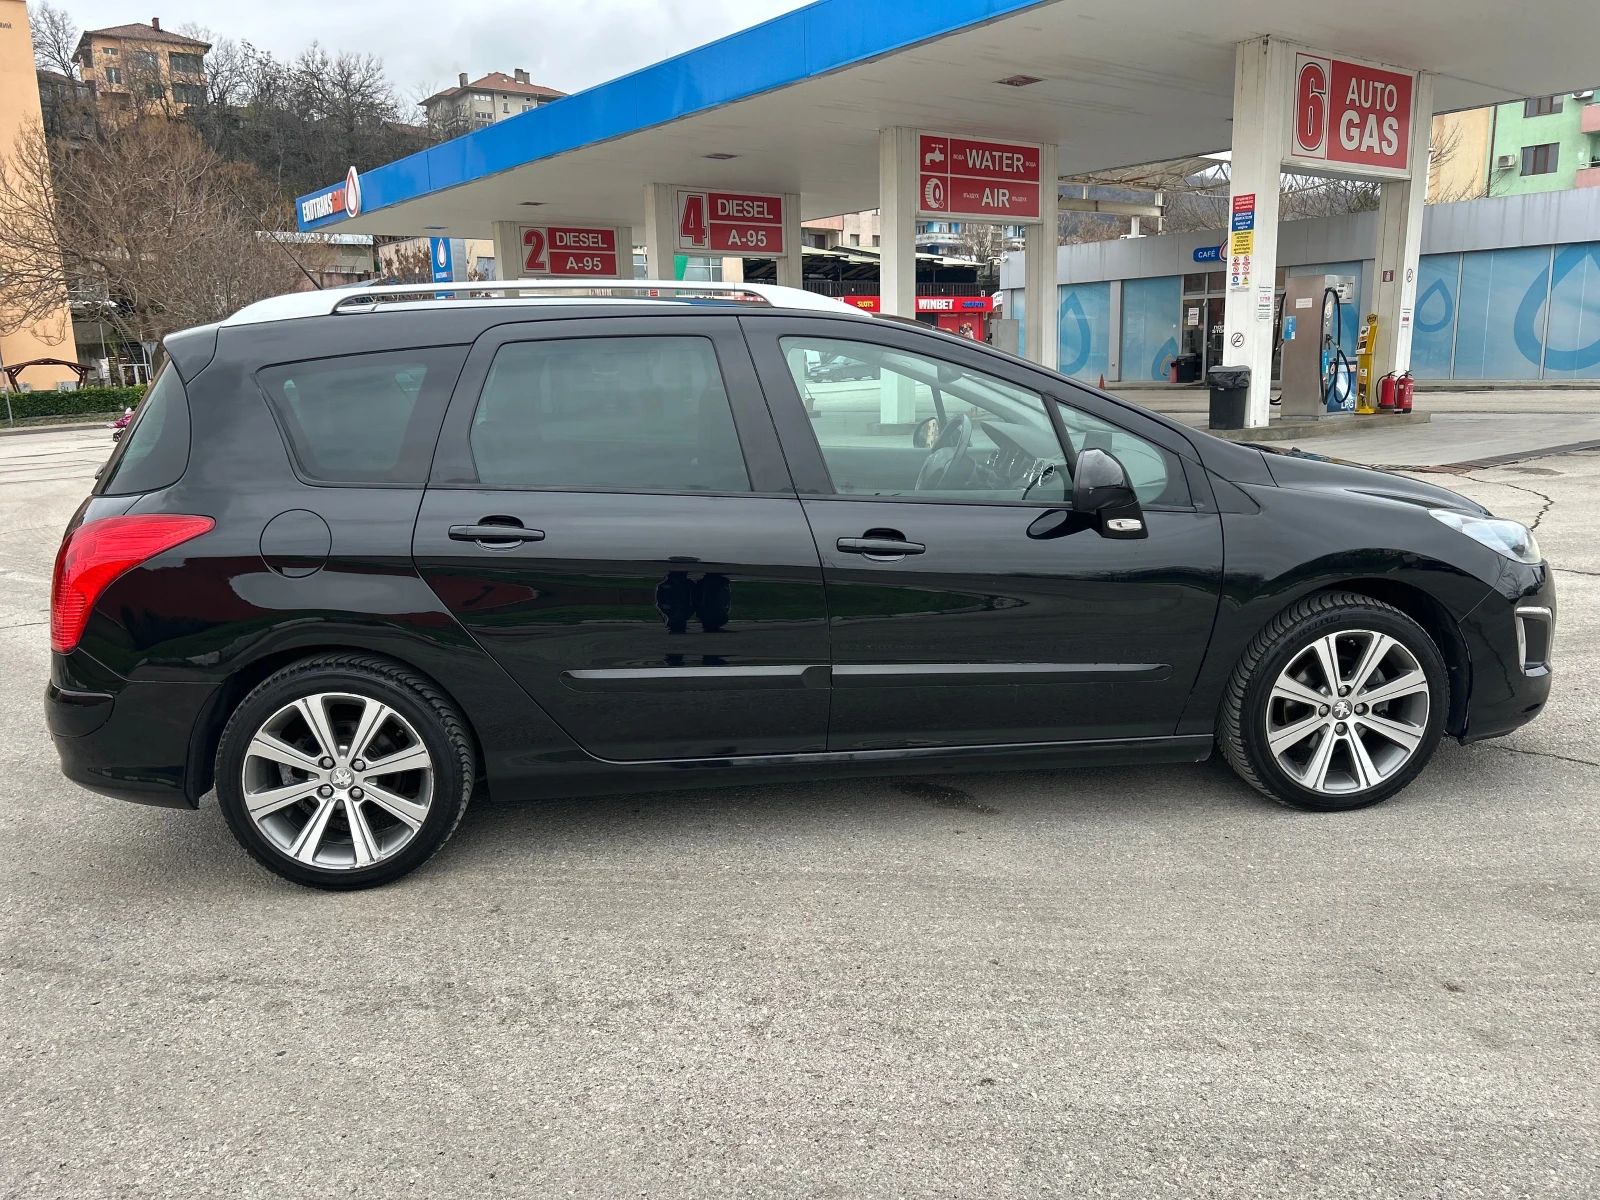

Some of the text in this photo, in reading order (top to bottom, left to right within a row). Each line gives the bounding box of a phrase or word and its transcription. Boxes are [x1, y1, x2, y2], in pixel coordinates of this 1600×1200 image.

[1346, 77, 1398, 112] AUTO
[1296, 62, 1326, 151] 6
[1340, 109, 1399, 156] GAS
[966, 148, 1024, 173] WATER
[981, 187, 1010, 208] AIR
[717, 198, 773, 219] DIESEL
[681, 195, 707, 246] 4
[555, 232, 608, 248] DIESEL
[727, 229, 767, 247] A-95
[523, 228, 546, 270] 2
[1198, 249, 1215, 258] CAFÉ
[566, 256, 602, 271] A-95
[918, 299, 954, 309] WINBET
[1341, 399, 1355, 409] LPG
